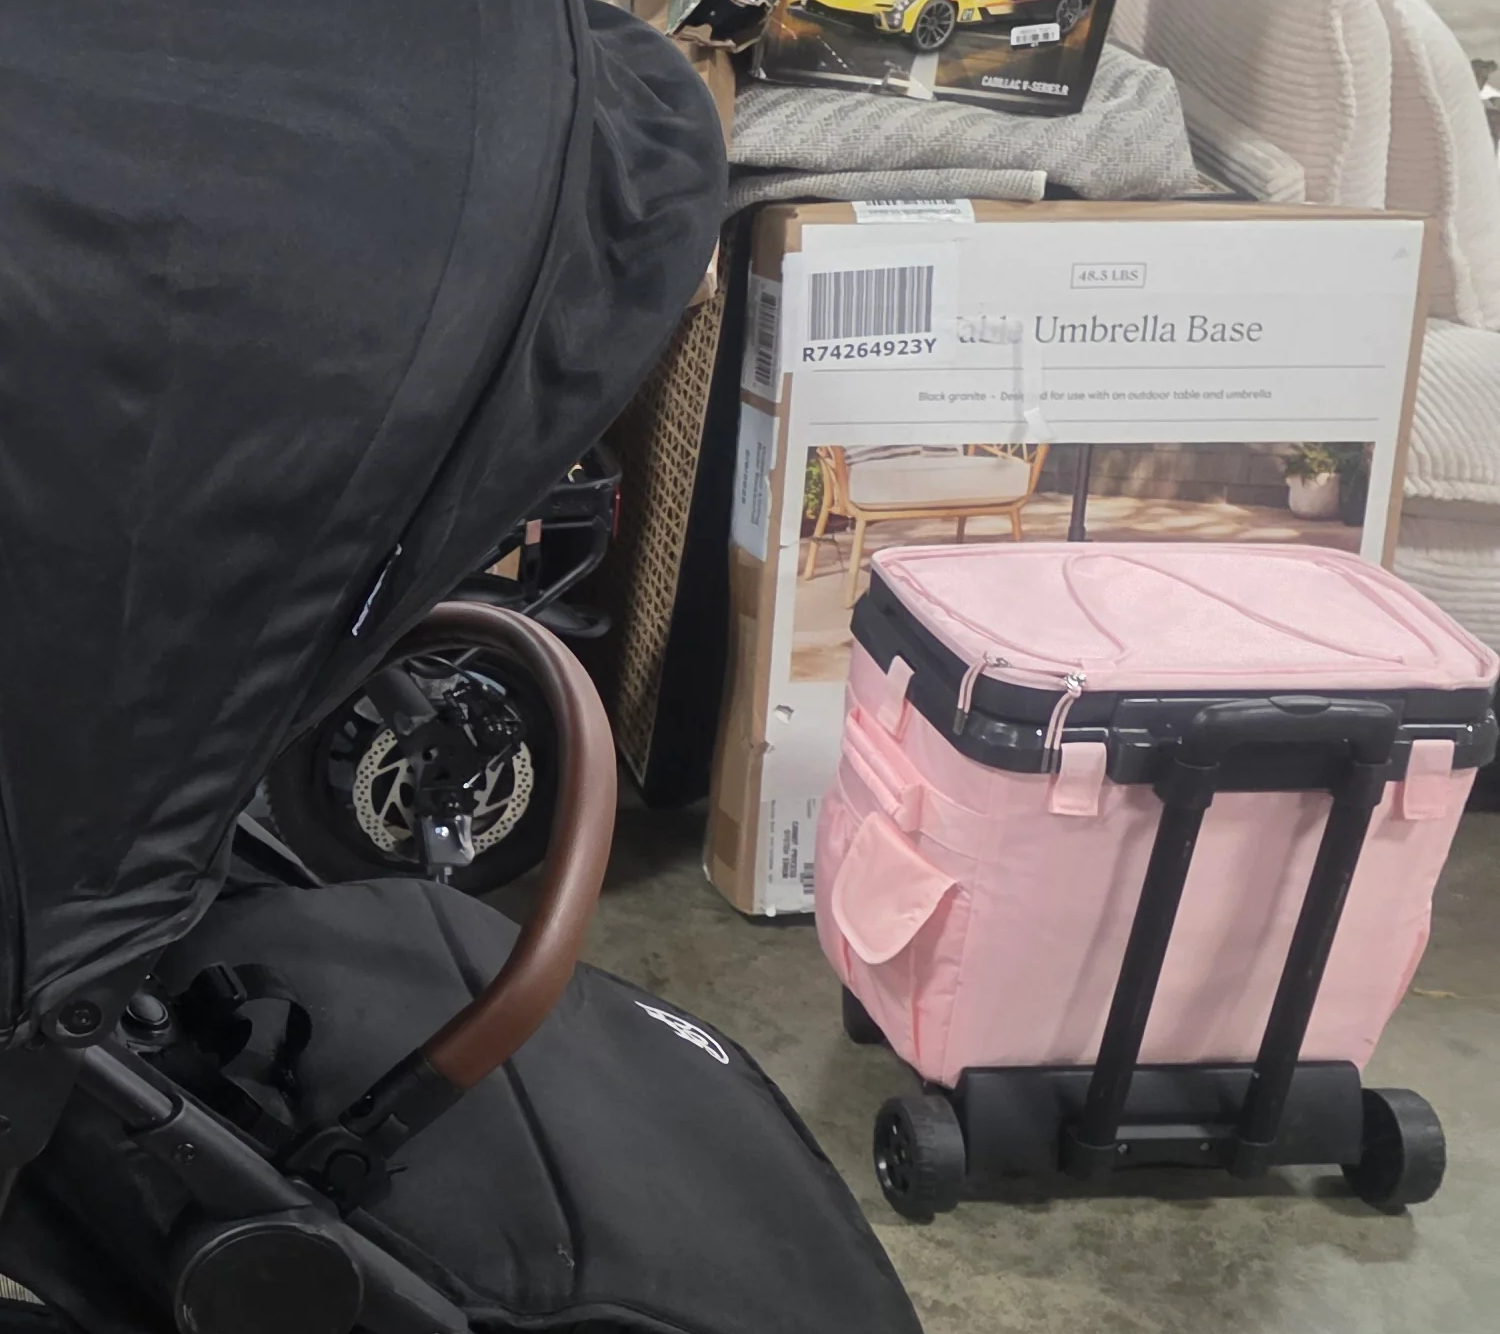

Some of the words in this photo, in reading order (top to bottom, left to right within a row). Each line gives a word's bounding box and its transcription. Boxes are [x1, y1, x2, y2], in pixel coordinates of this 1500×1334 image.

[1111, 269, 1139, 282] LBS
[1034, 315, 1177, 344] Umbrella
[1186, 315, 1264, 344] Base
[802, 337, 937, 362] R74264923Y
